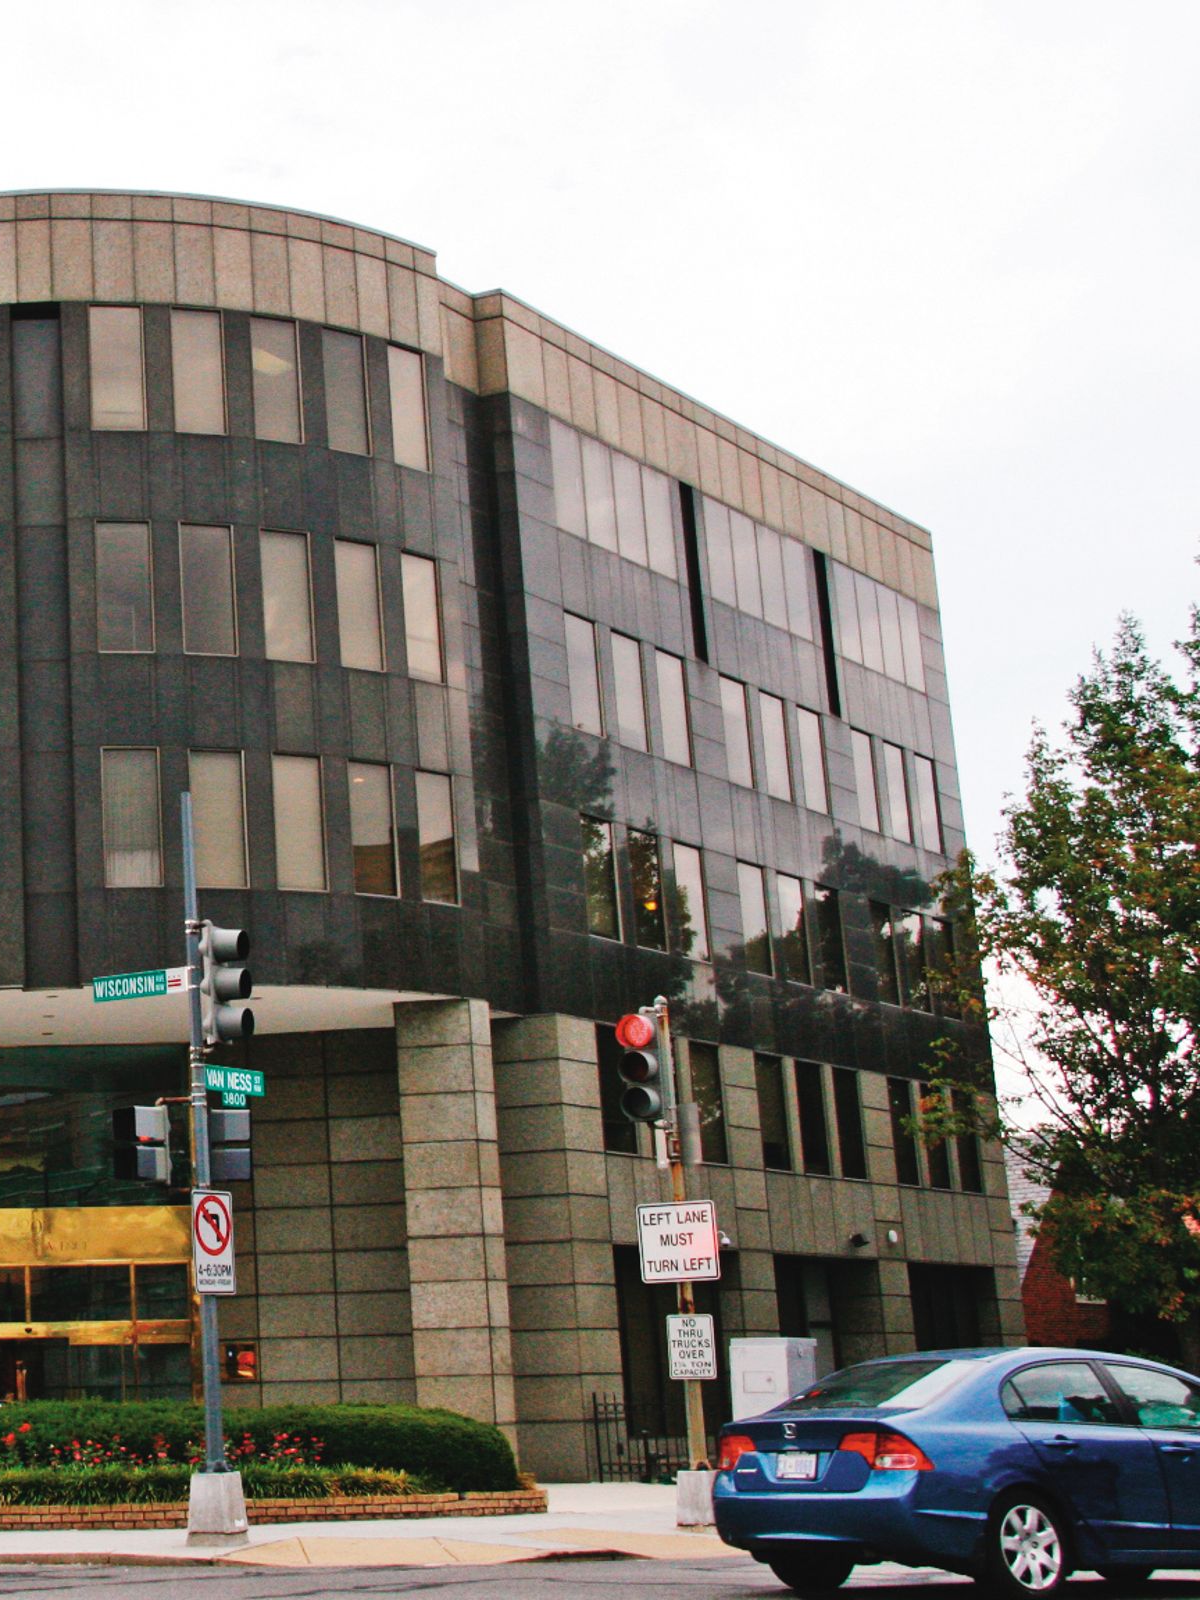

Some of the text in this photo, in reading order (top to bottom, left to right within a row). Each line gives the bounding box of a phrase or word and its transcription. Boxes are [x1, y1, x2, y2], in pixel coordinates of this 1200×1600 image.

[94, 975, 155, 998] WISCONSIN
[206, 1069, 252, 1092] VAN NESS
[224, 1092, 246, 1106] 3800
[642, 1210, 708, 1225] LEFT LANE
[660, 1232, 693, 1246] MUST
[647, 1257, 712, 1273] TURN LEFT
[681, 1319, 696, 1327] NO
[678, 1329, 703, 1338] THRU
[672, 1339, 711, 1348] TRUCKS
[679, 1350, 705, 1359] OVER
